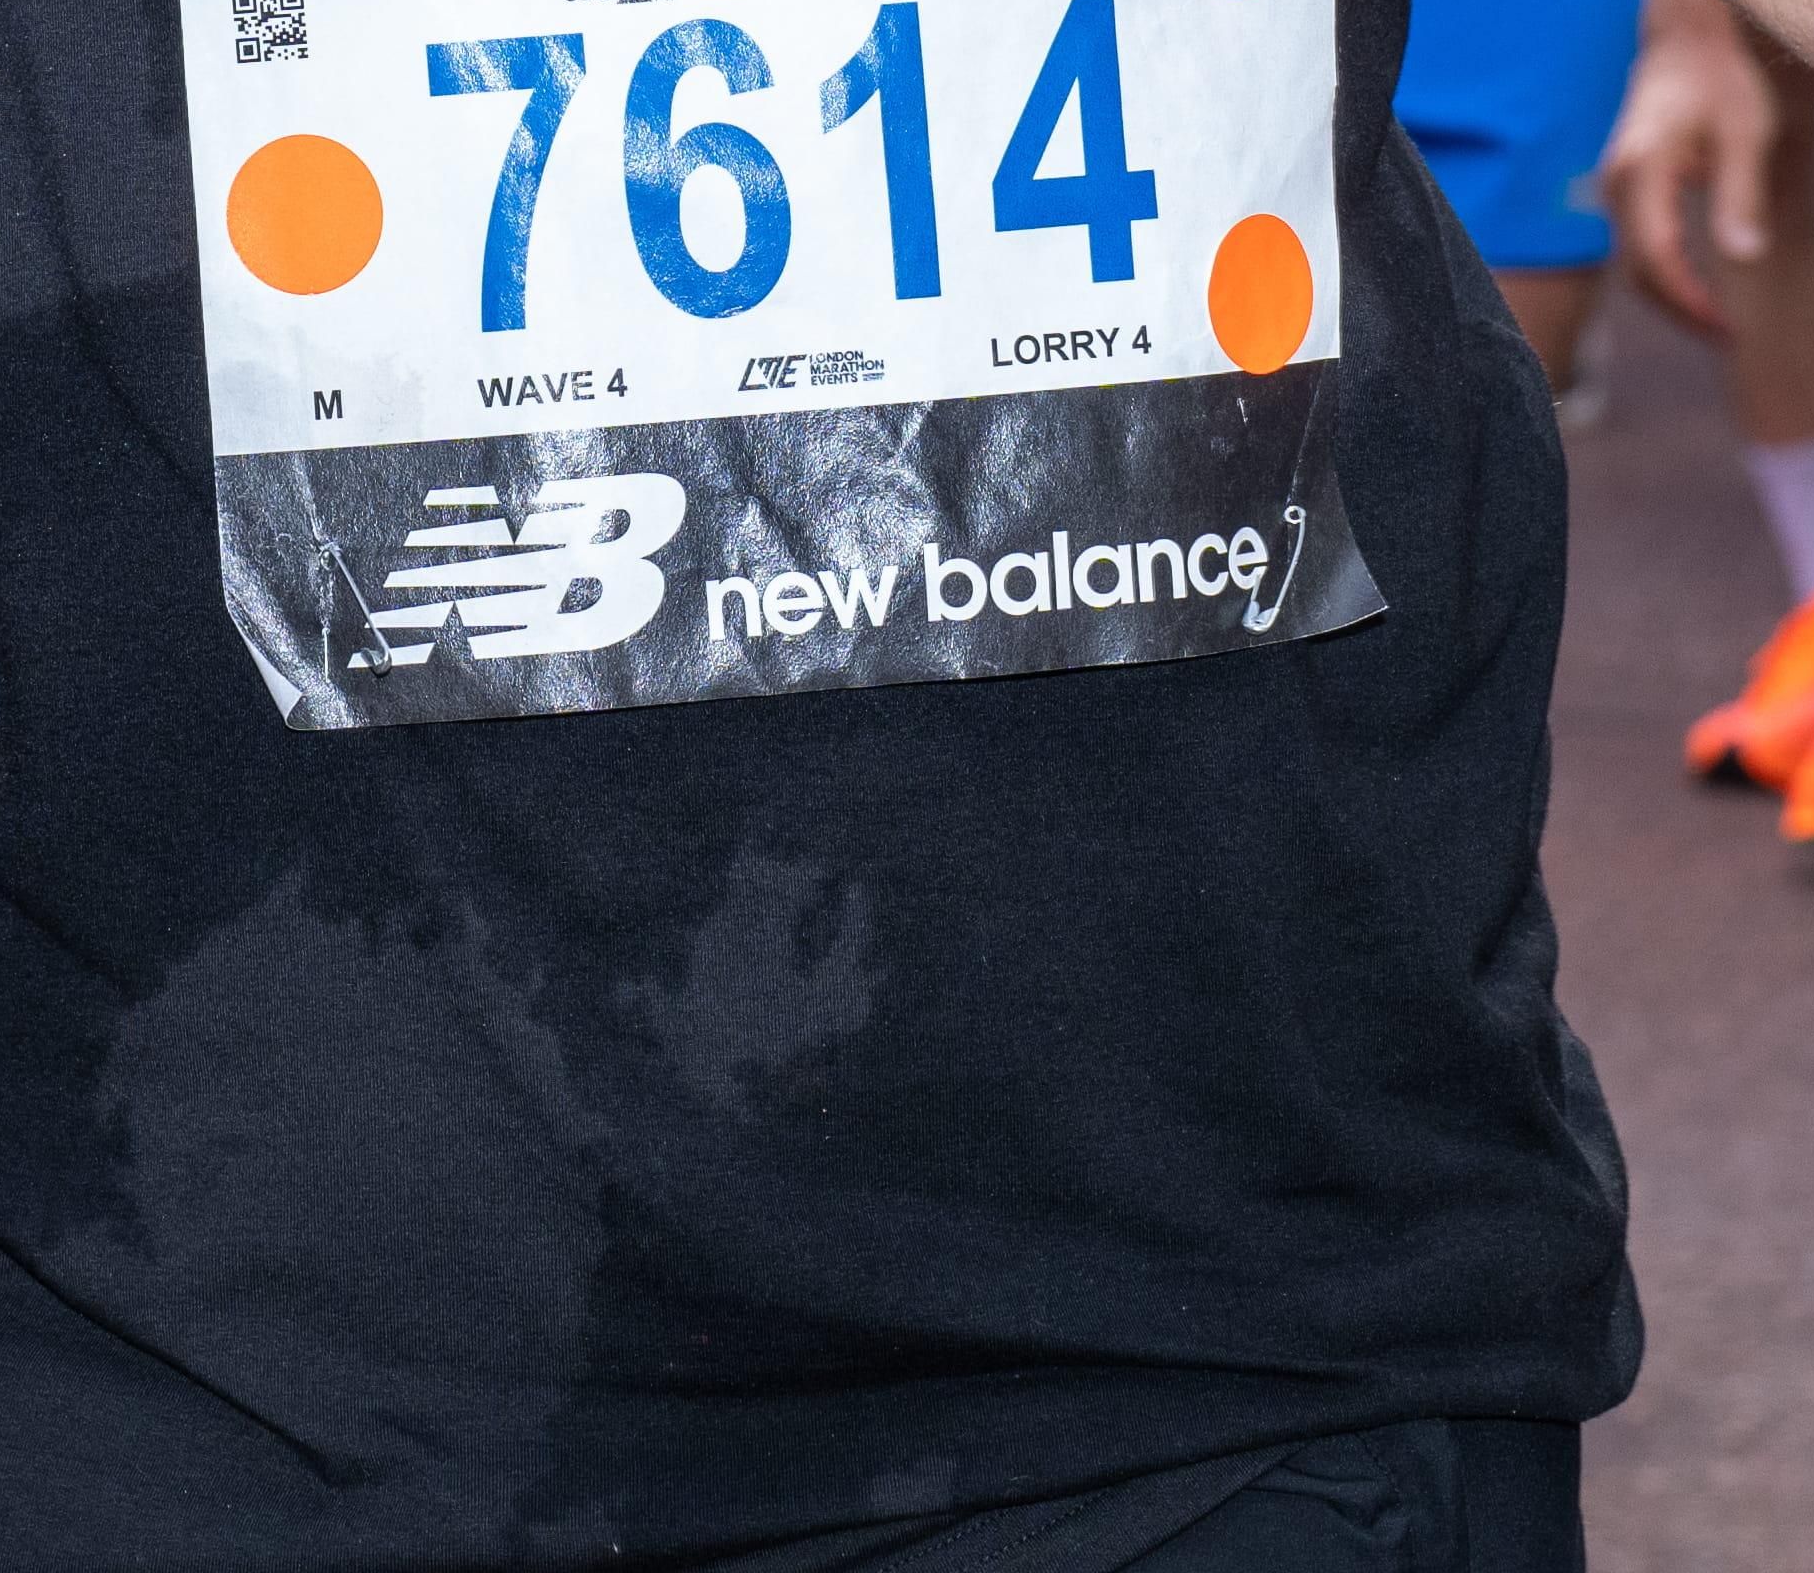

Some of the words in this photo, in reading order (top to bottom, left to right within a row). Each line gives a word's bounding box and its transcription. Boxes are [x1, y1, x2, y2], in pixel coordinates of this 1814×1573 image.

[809, 350, 864, 365] LONDON
[990, 327, 1121, 368] LORRY
[1130, 324, 1153, 355] 4
[810, 360, 885, 376] MARATHON
[810, 372, 858, 386] EVENTS
[312, 388, 345, 421] M
[477, 369, 596, 409] WAVE
[605, 367, 629, 399] 4
[707, 564, 899, 643] new
[924, 525, 1273, 623] balance
